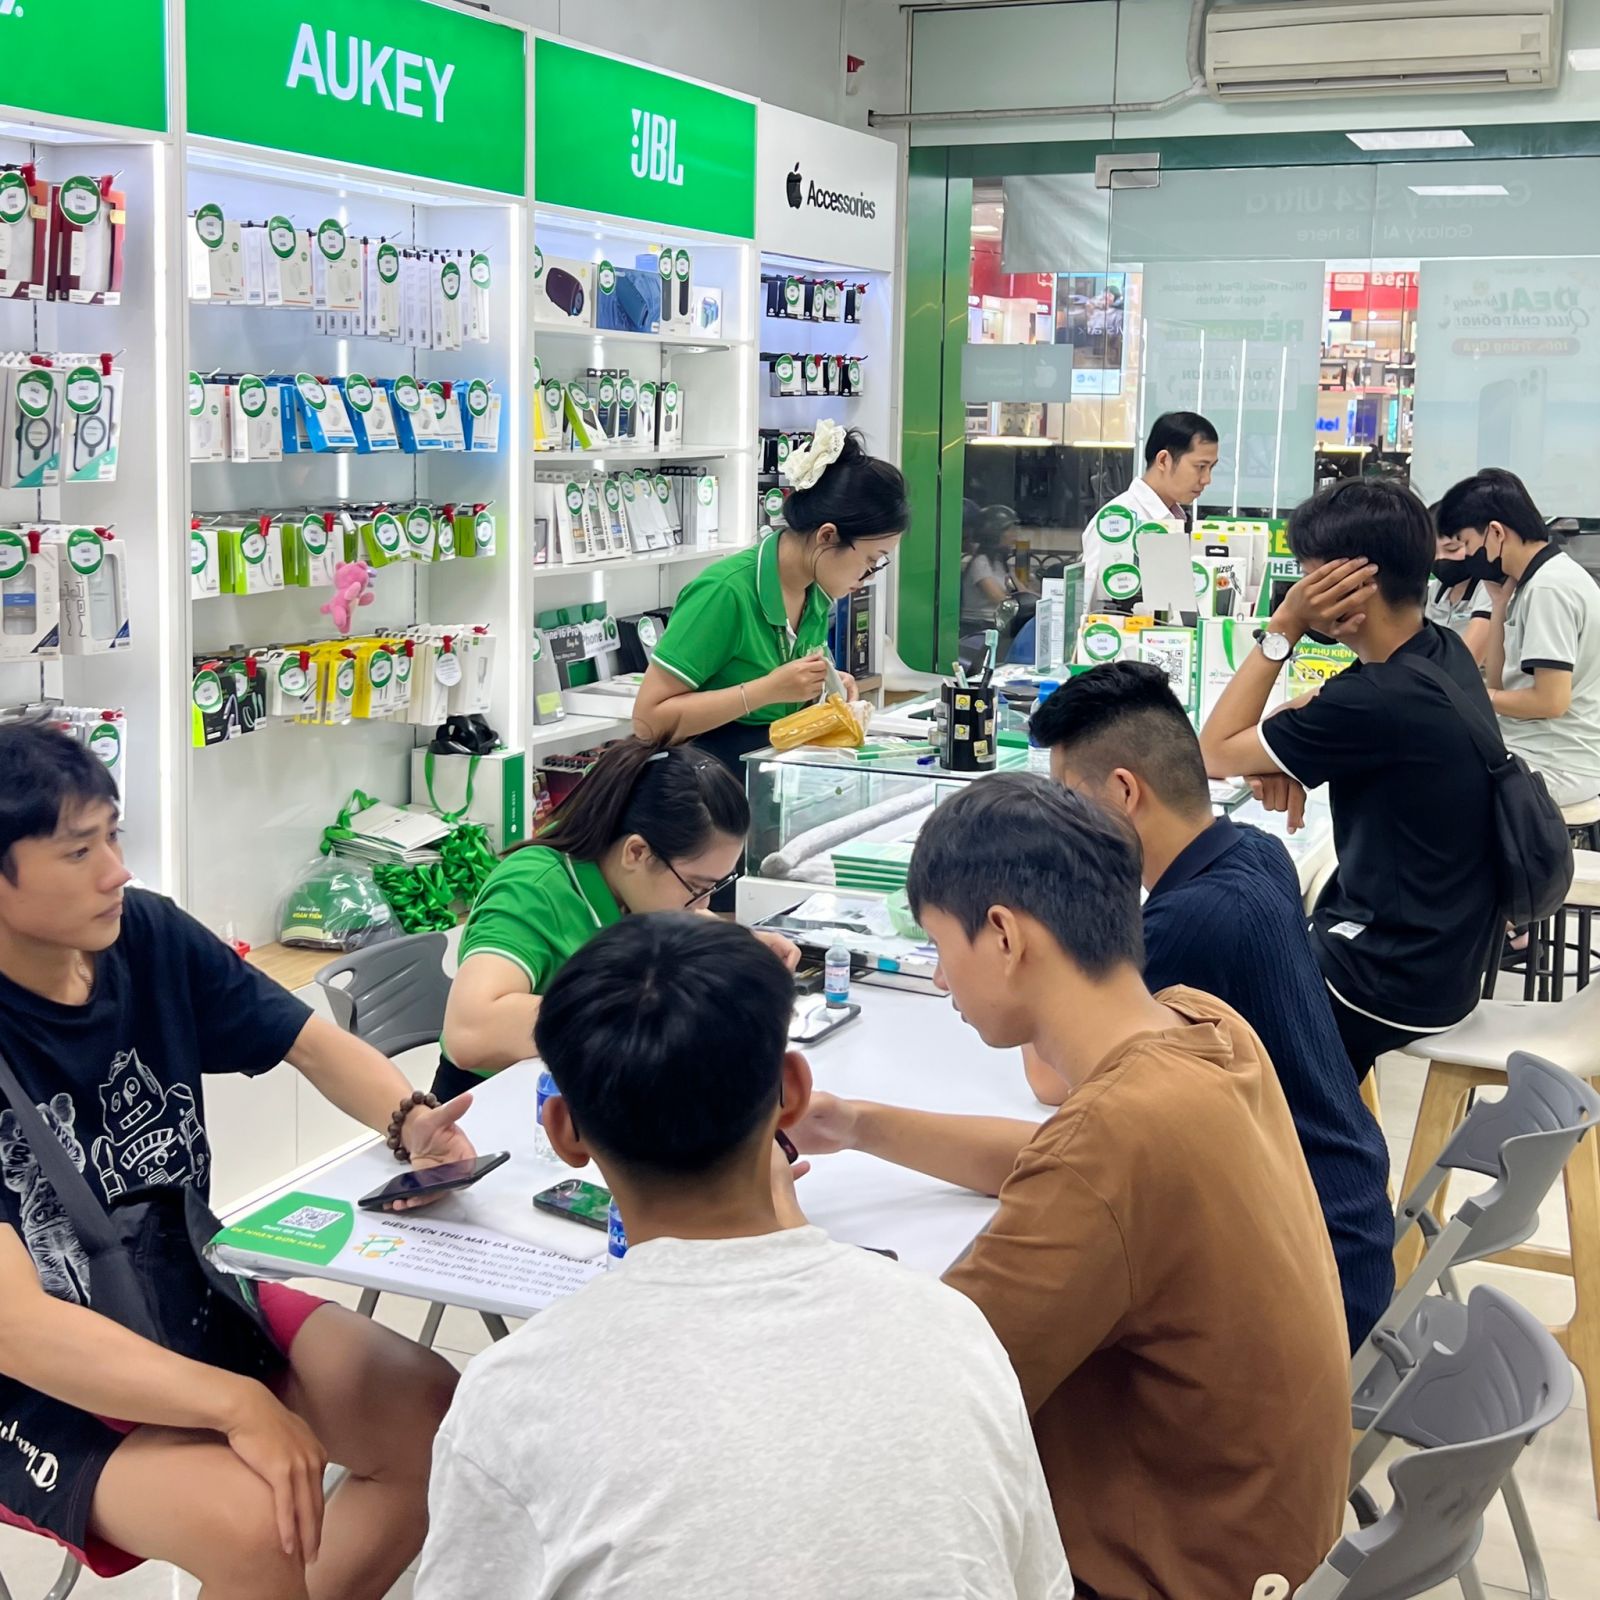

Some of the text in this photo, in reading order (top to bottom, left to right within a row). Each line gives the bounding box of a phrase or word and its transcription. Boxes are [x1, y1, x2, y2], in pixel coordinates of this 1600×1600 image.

[286, 22, 456, 124] AUKEY
[806, 179, 877, 220] Accessories
[439, 1231, 464, 1241] THU
[511, 1245, 537, 1255] QUA
